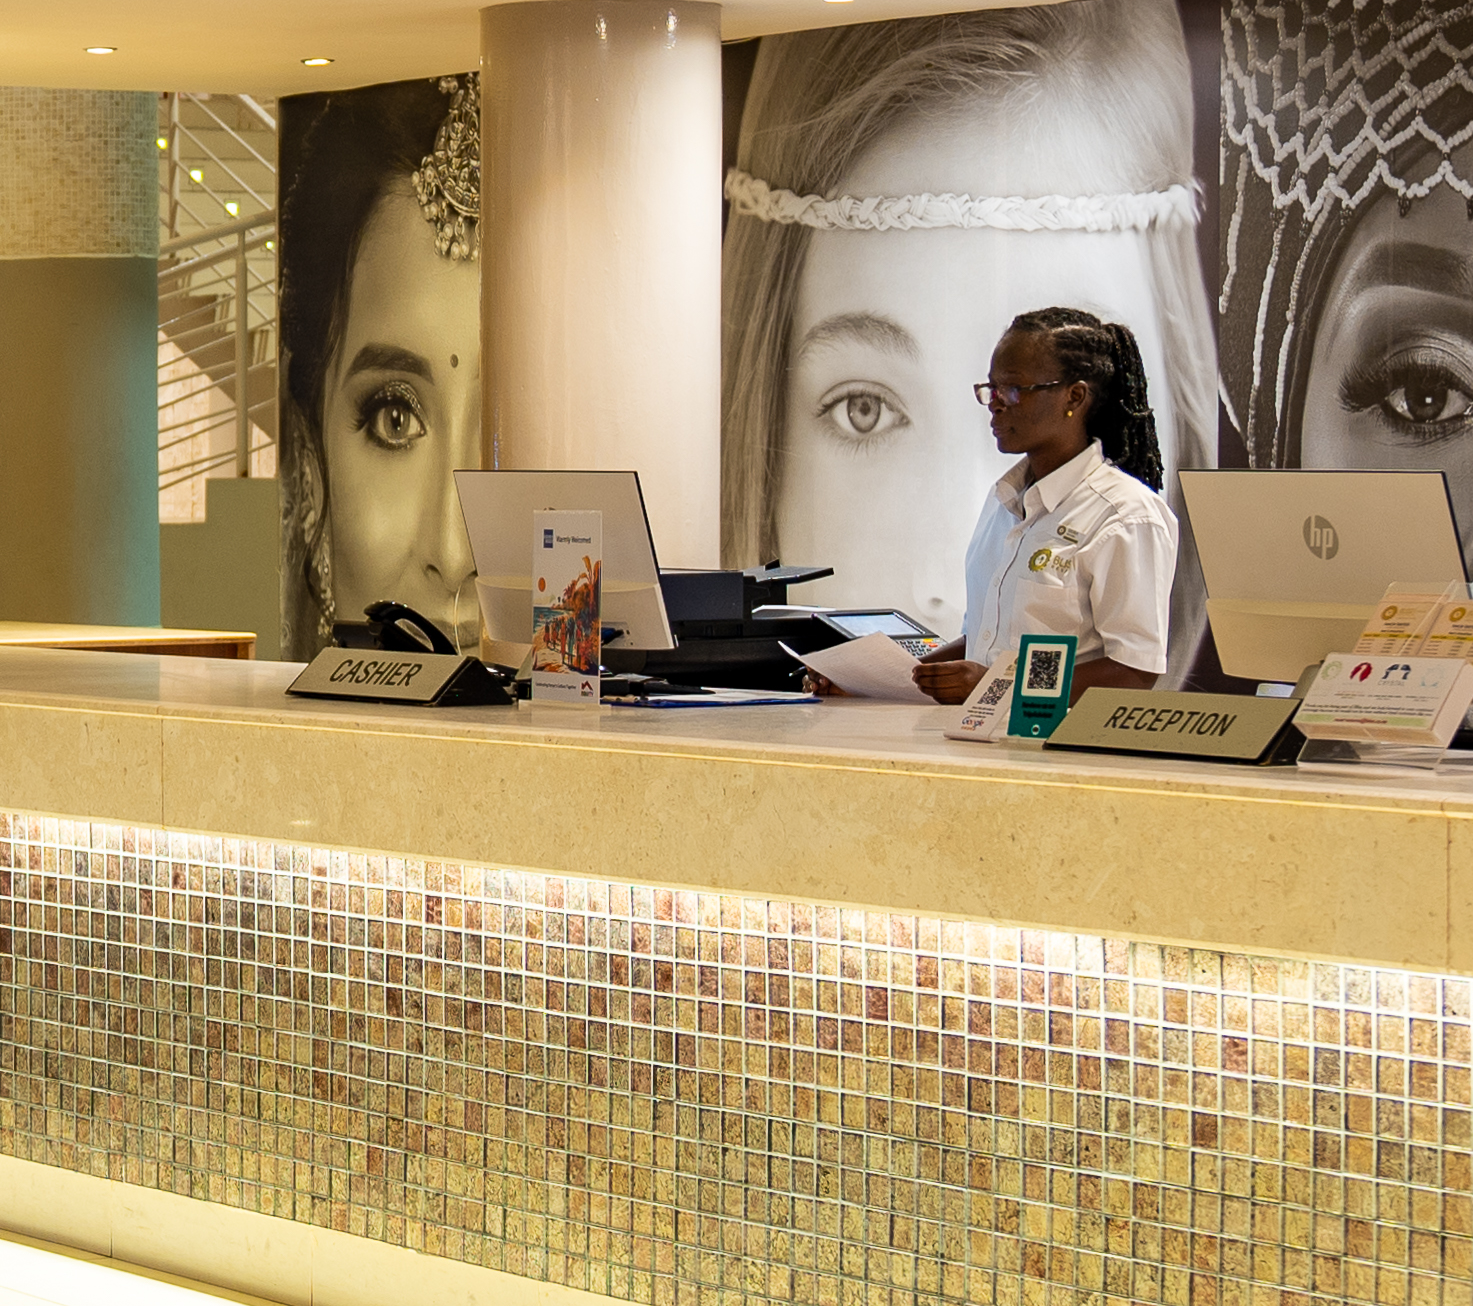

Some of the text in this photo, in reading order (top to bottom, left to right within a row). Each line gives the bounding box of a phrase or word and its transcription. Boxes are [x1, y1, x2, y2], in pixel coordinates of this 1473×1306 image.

[1309, 513, 1334, 561] hp
[329, 658, 423, 687] CASHIER
[1103, 705, 1238, 737] RECEPTION
